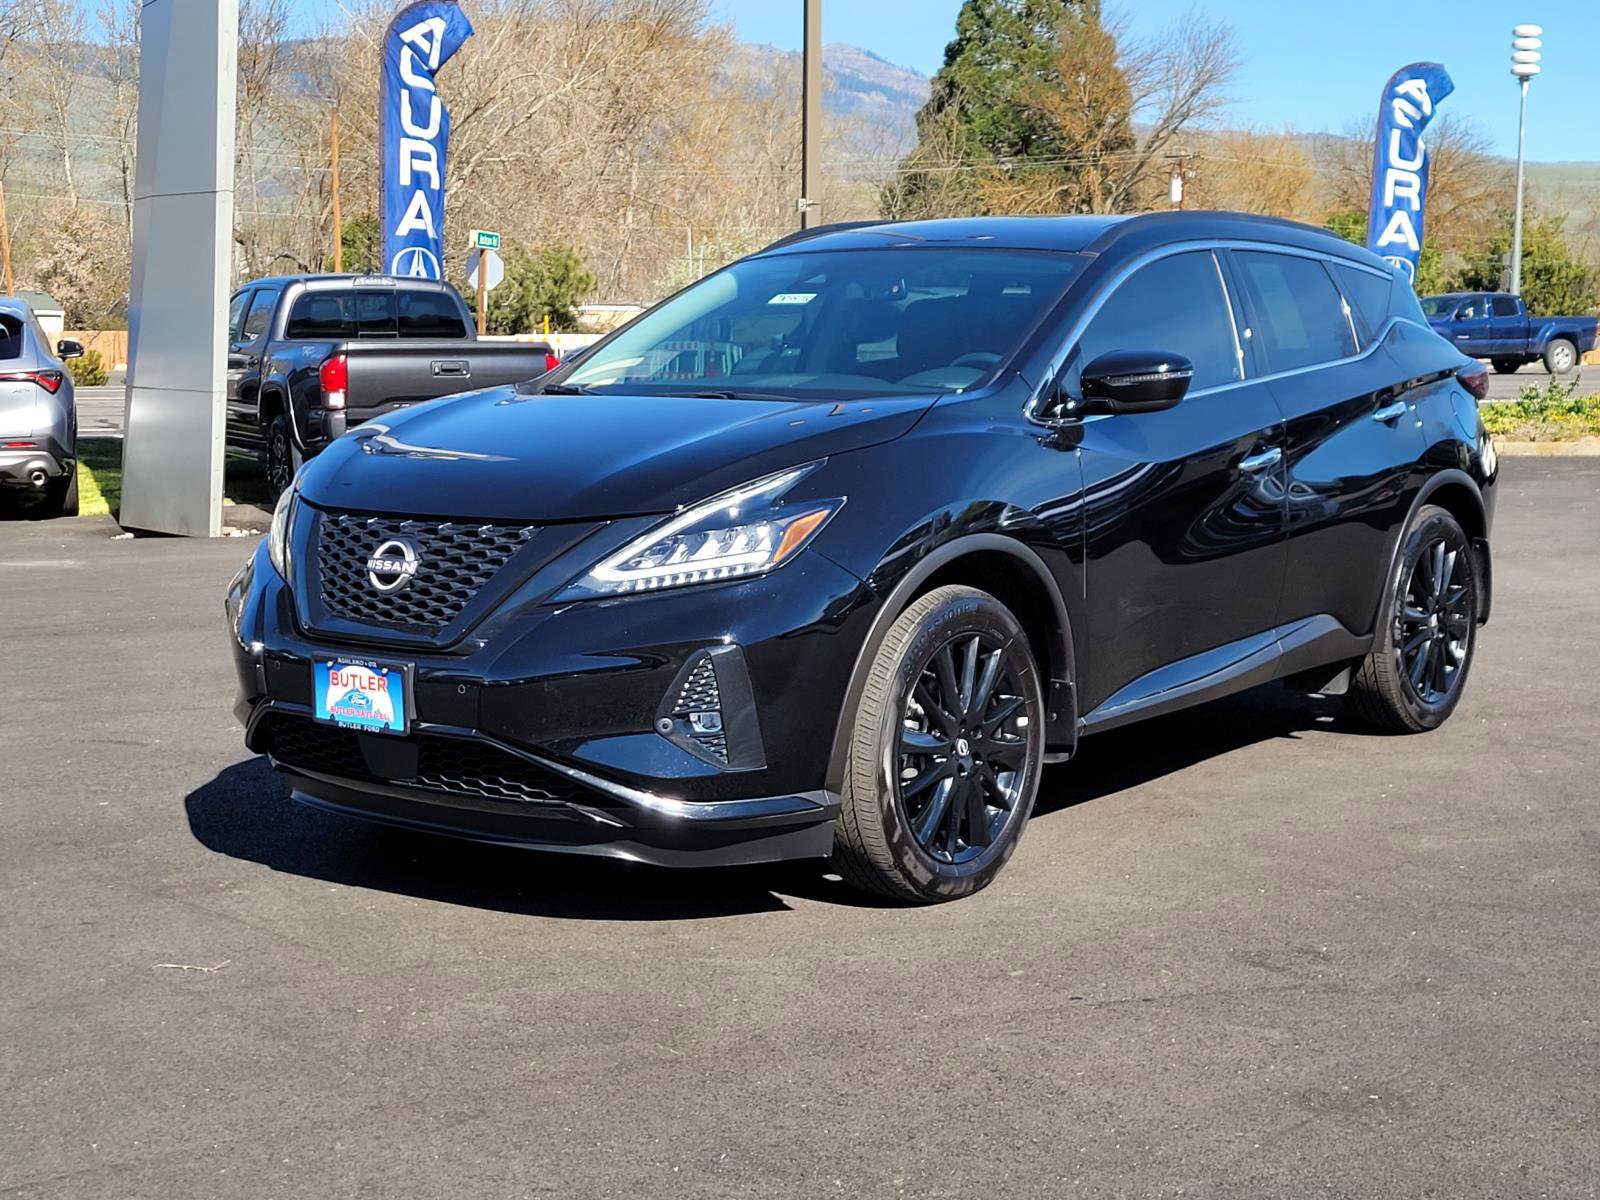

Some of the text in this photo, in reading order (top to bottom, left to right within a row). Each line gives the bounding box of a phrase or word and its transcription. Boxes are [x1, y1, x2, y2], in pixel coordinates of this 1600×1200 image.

[395, 16, 446, 239] ACURA
[366, 559, 419, 575] NISSAN
[330, 671, 387, 693] BUTLER
[338, 721, 380, 733] BUTLER FORD
